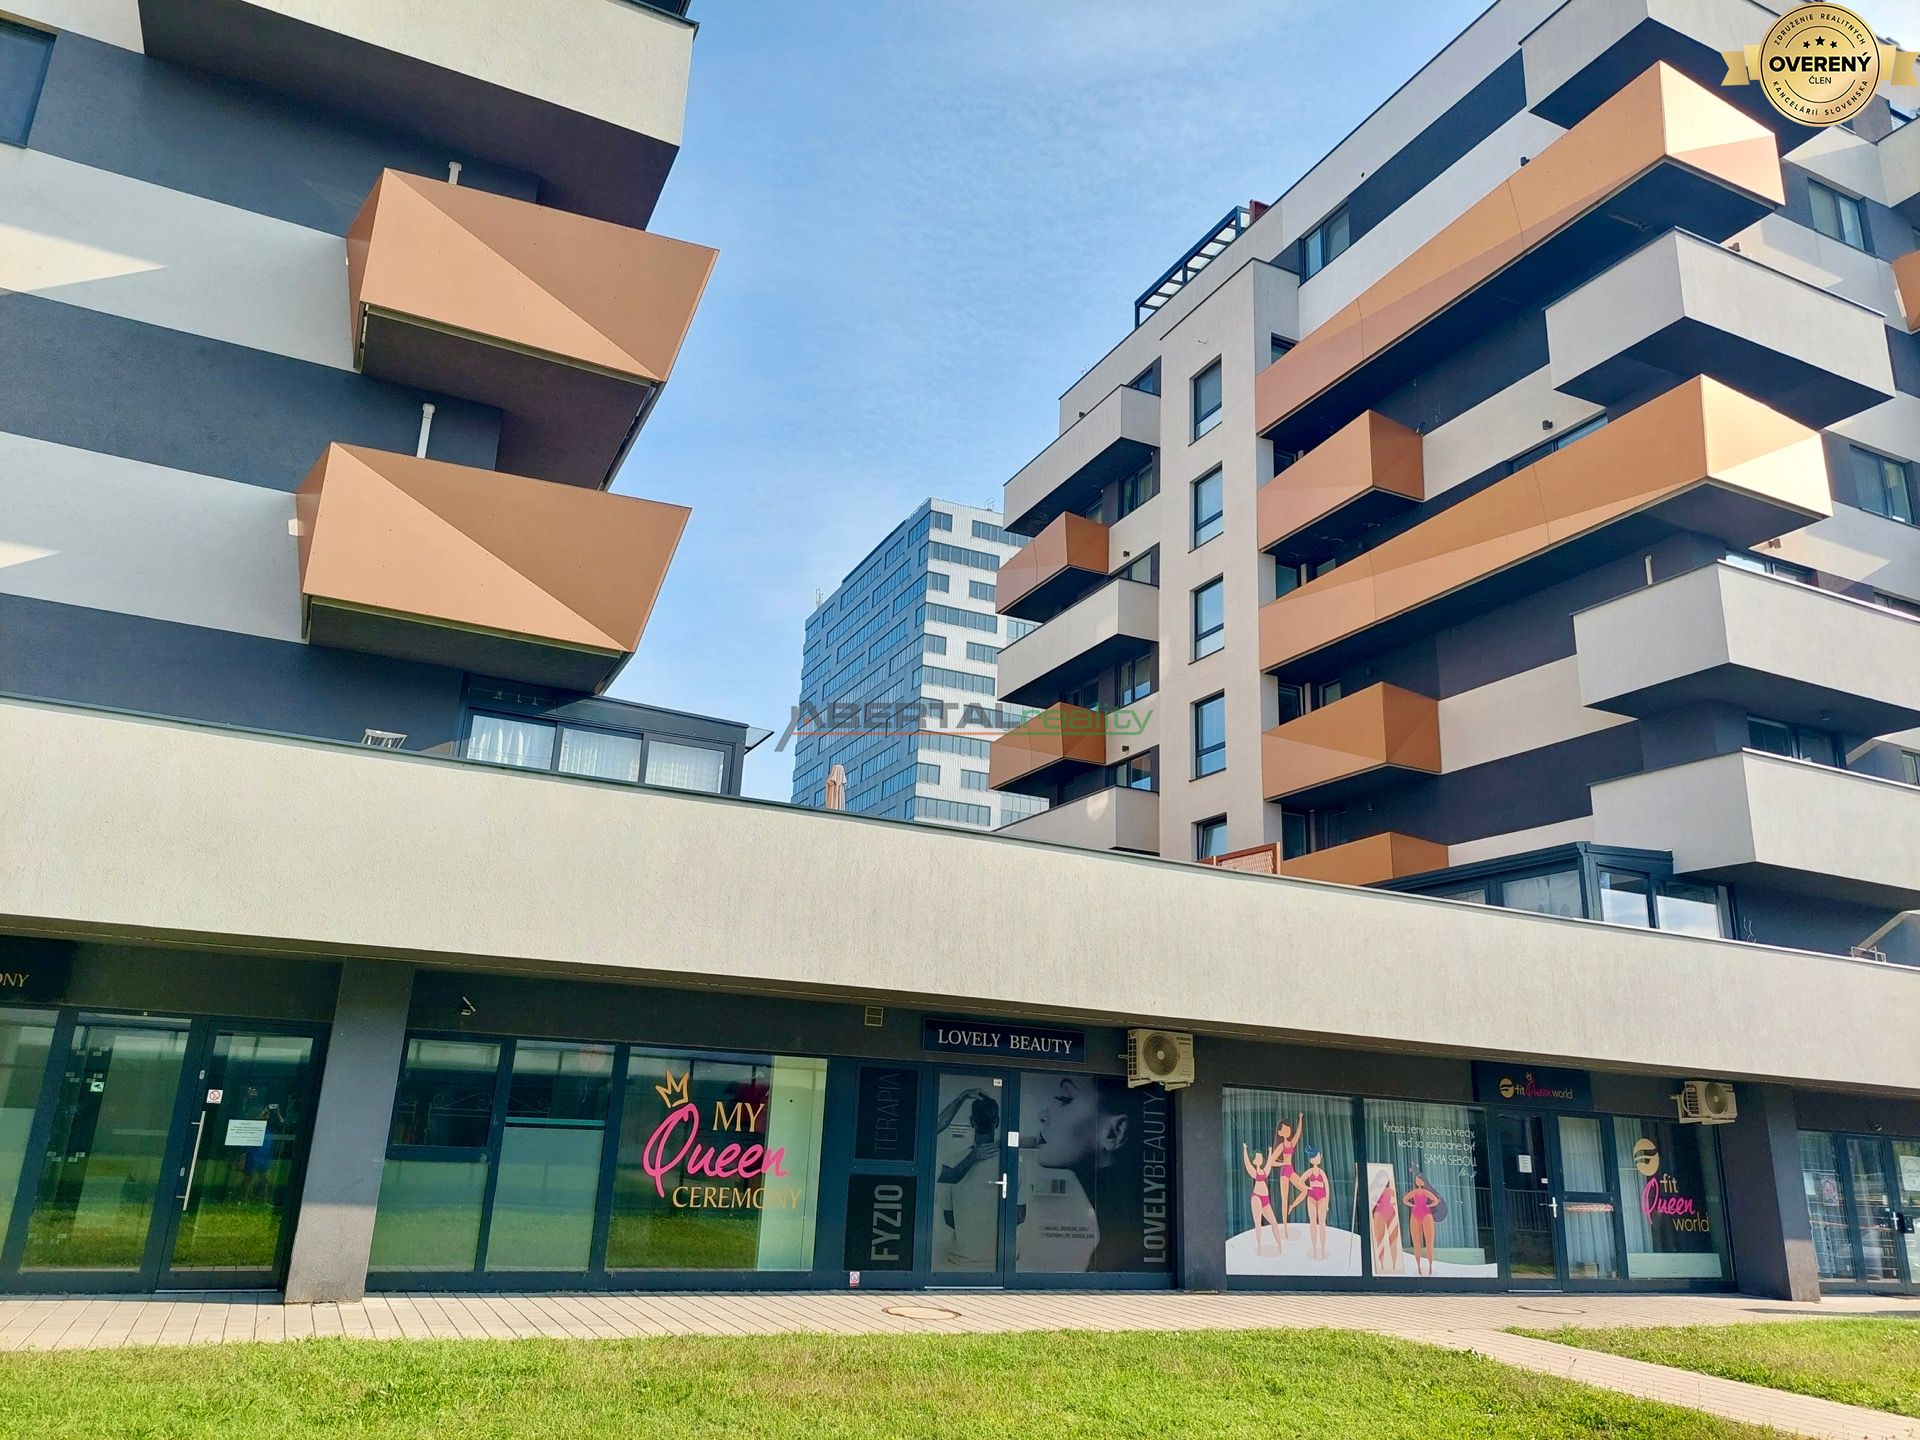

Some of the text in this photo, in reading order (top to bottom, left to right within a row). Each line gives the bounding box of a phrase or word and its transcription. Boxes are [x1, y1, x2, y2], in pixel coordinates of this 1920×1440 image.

[0, 972, 30, 988] NY
[938, 1029, 1072, 1055] LOVELY BEAUTY
[1552, 1088, 1573, 1099] world
[712, 1101, 765, 1132] MY
[875, 1073, 899, 1153] TERAPIA
[642, 1102, 788, 1198] Queen
[1424, 1153, 1447, 1165] SAMA
[1660, 1173, 1678, 1193] fit
[672, 1186, 801, 1209] CEREMONY
[1642, 1177, 1695, 1224] Queen
[871, 1184, 904, 1261] FYZIO
[1672, 1211, 1709, 1232] world
